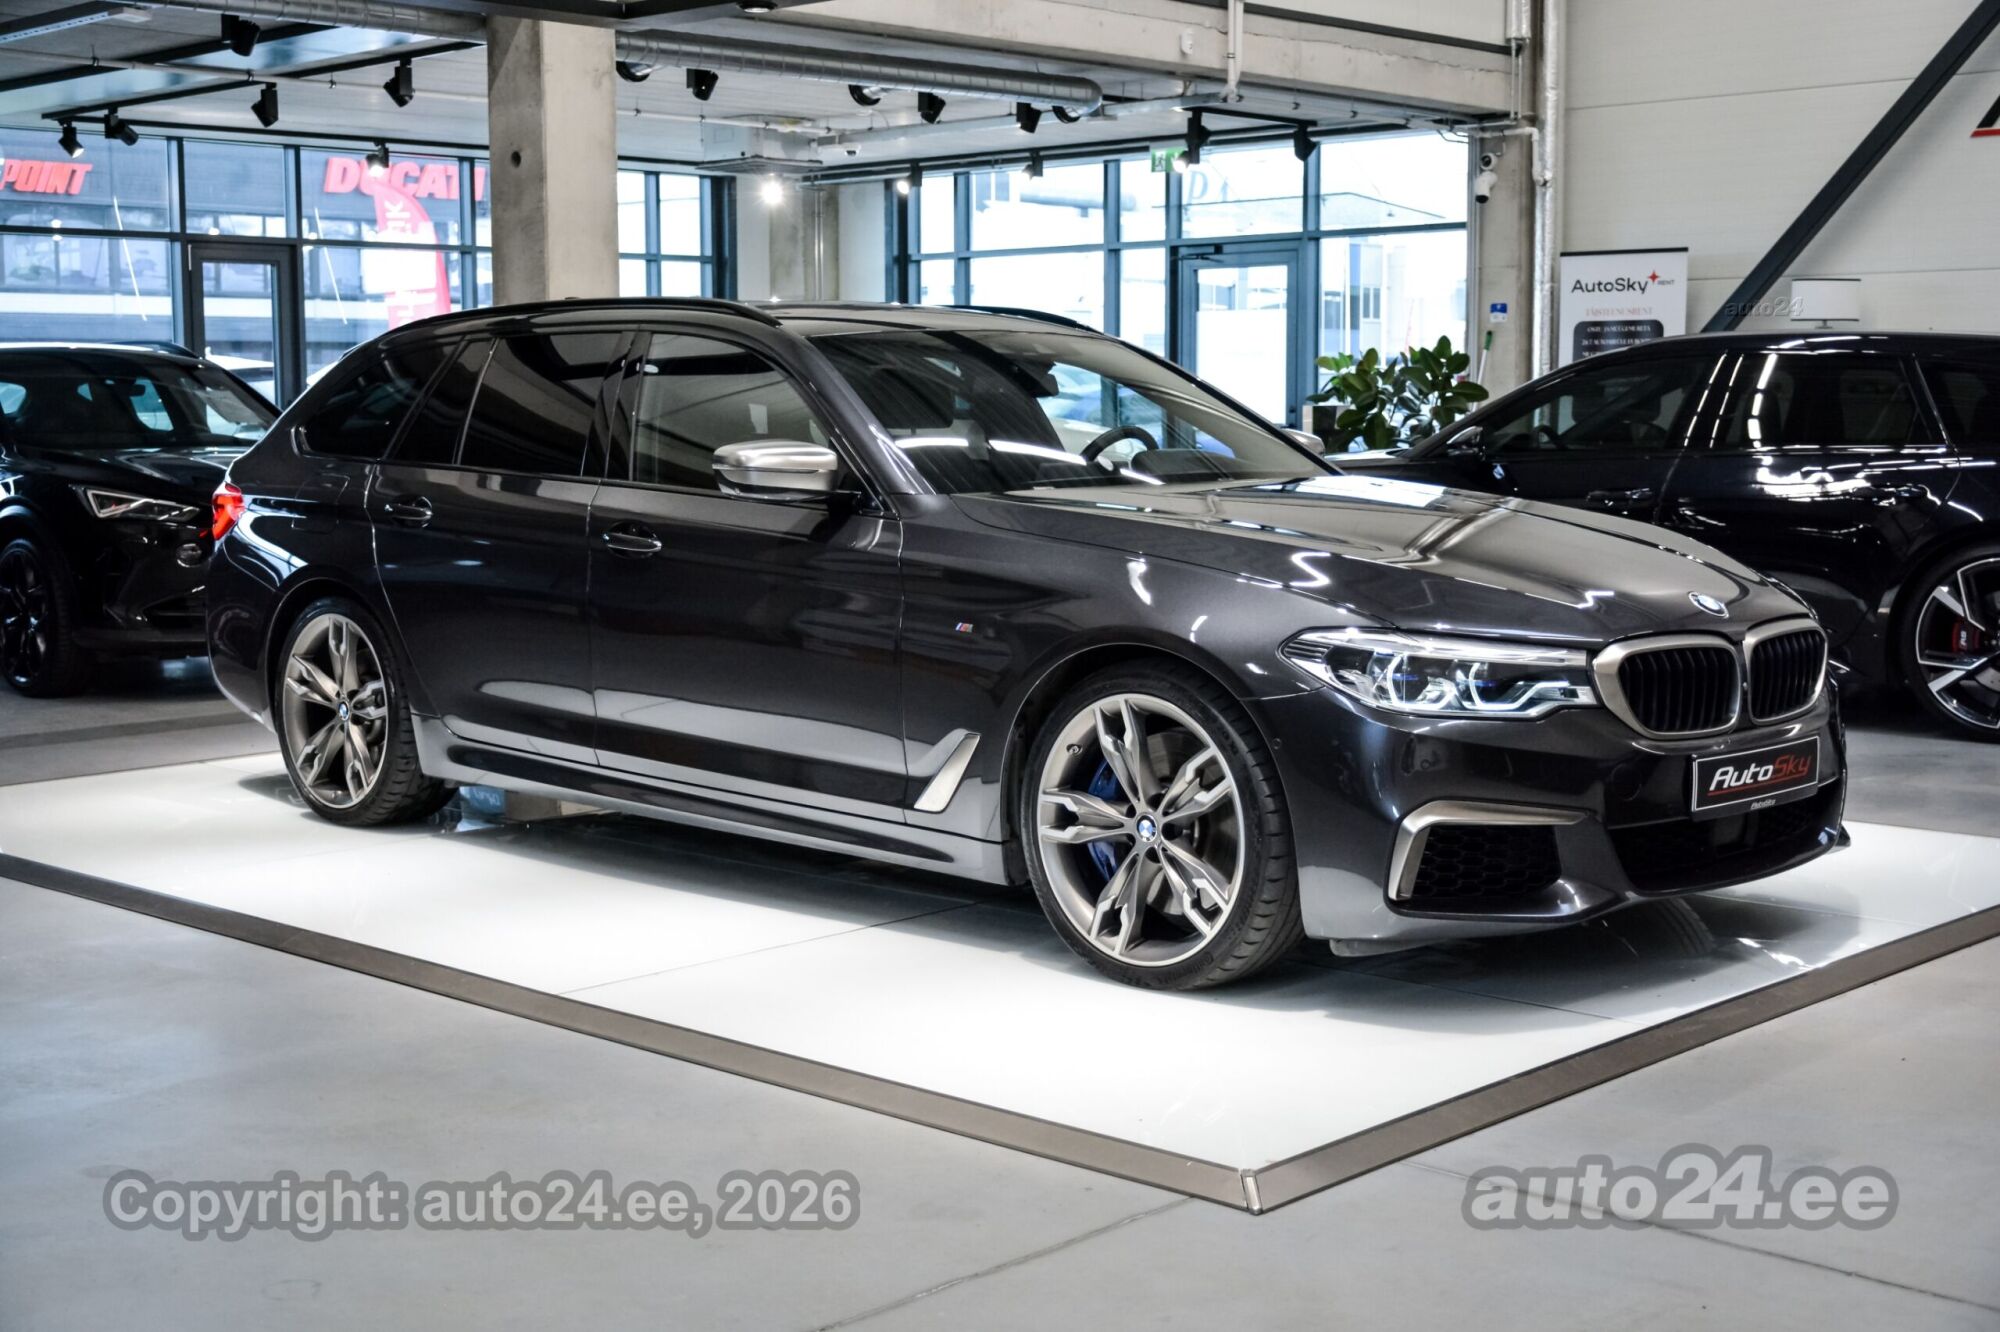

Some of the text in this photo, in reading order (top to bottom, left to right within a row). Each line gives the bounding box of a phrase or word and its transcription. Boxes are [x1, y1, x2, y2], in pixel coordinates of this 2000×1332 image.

[0, 159, 93, 195] POINT
[1571, 277, 1648, 295] AutoSky
[1709, 754, 1811, 791] AutoSky
